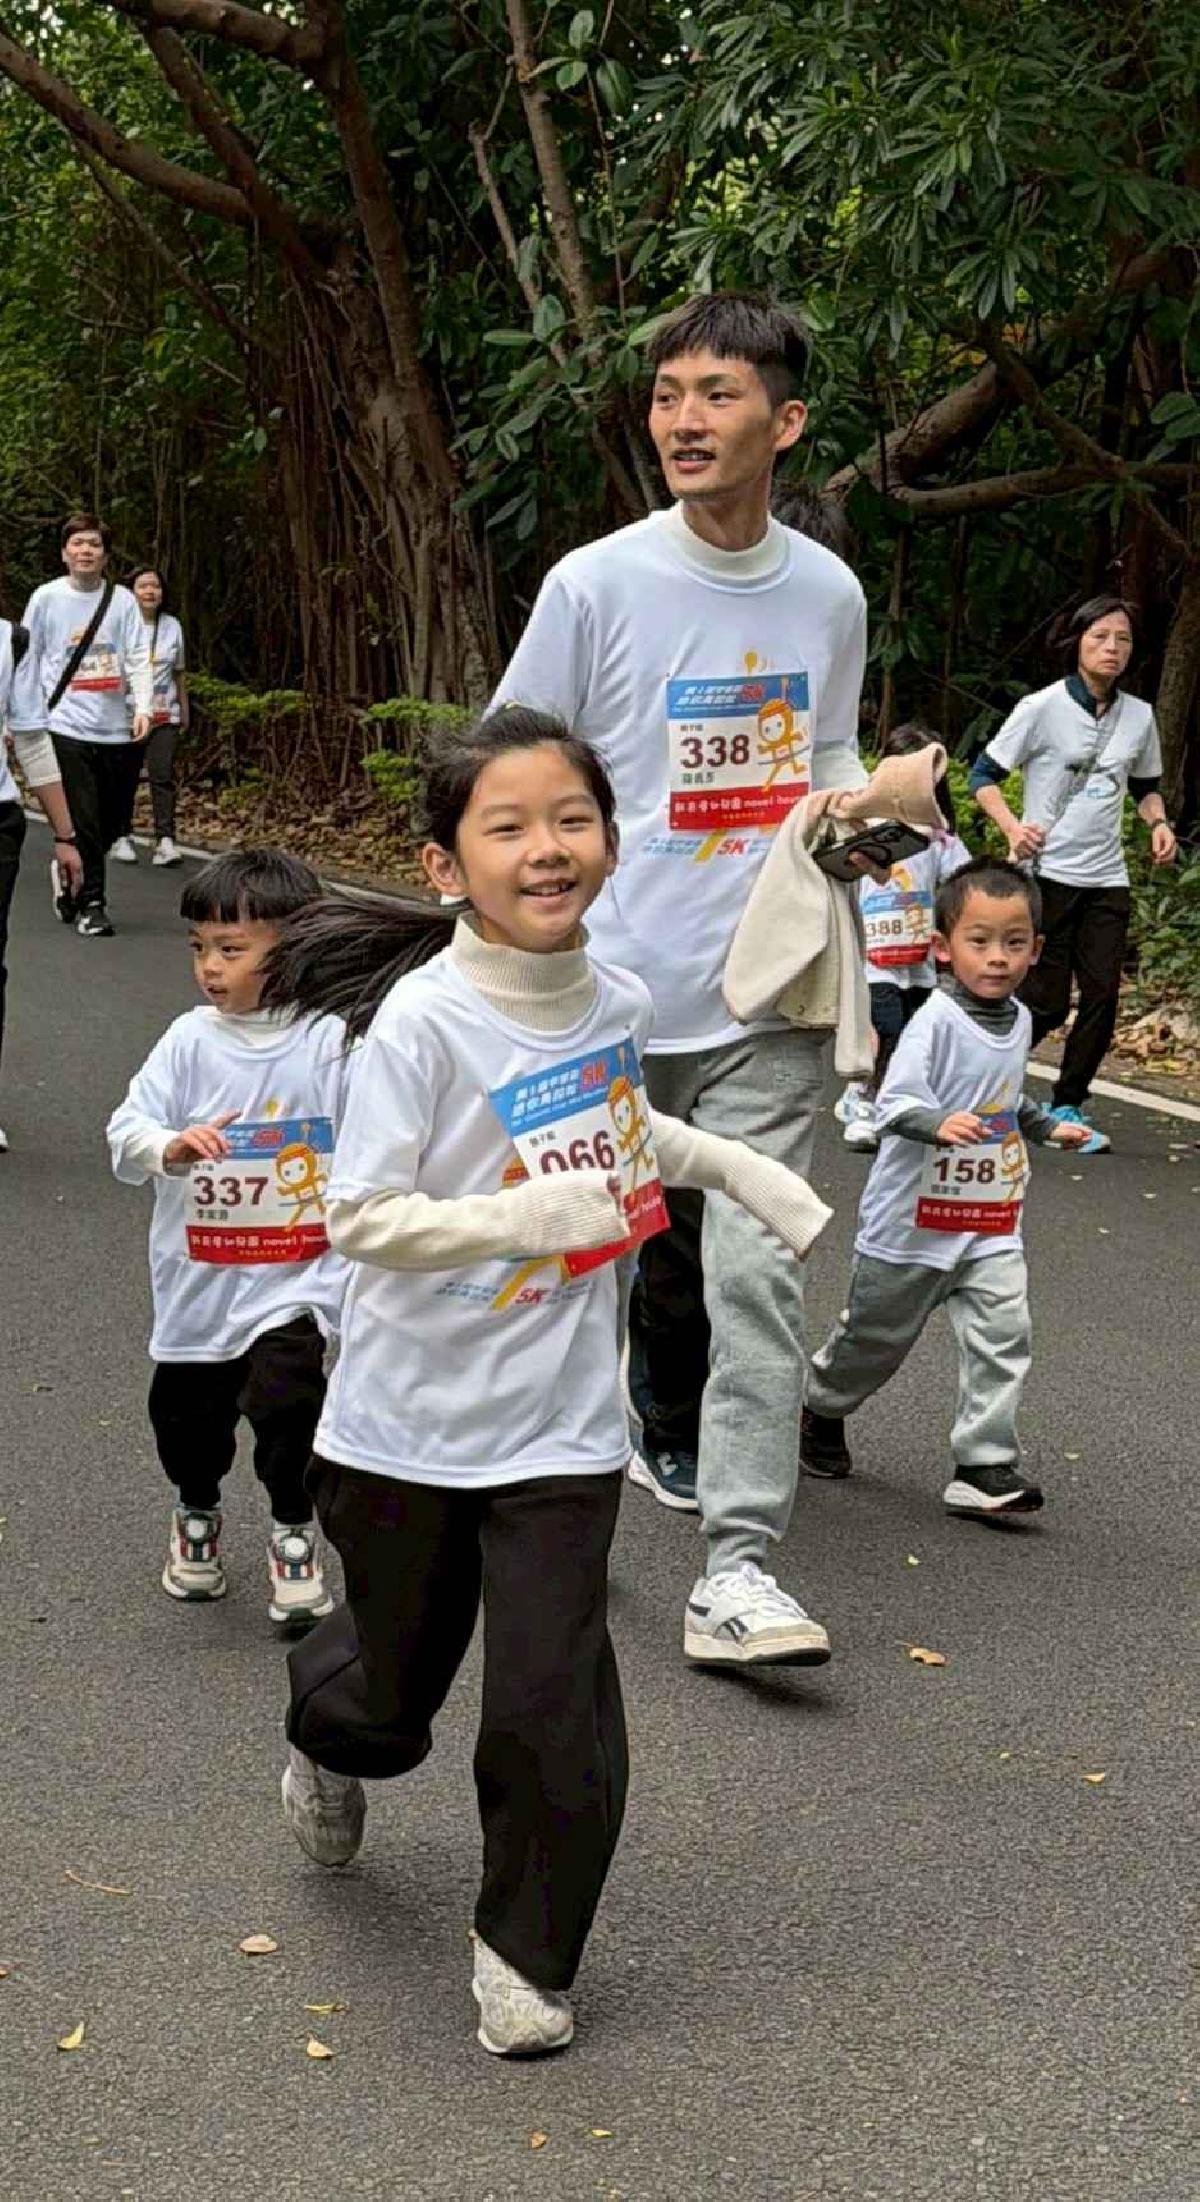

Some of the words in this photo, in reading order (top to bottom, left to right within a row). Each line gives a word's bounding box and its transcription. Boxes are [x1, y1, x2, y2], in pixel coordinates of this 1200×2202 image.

[680, 734, 750, 769] 338
[866, 919, 903, 937] 388
[933, 1157, 996, 1185] 158
[194, 1176, 269, 1206] 337
